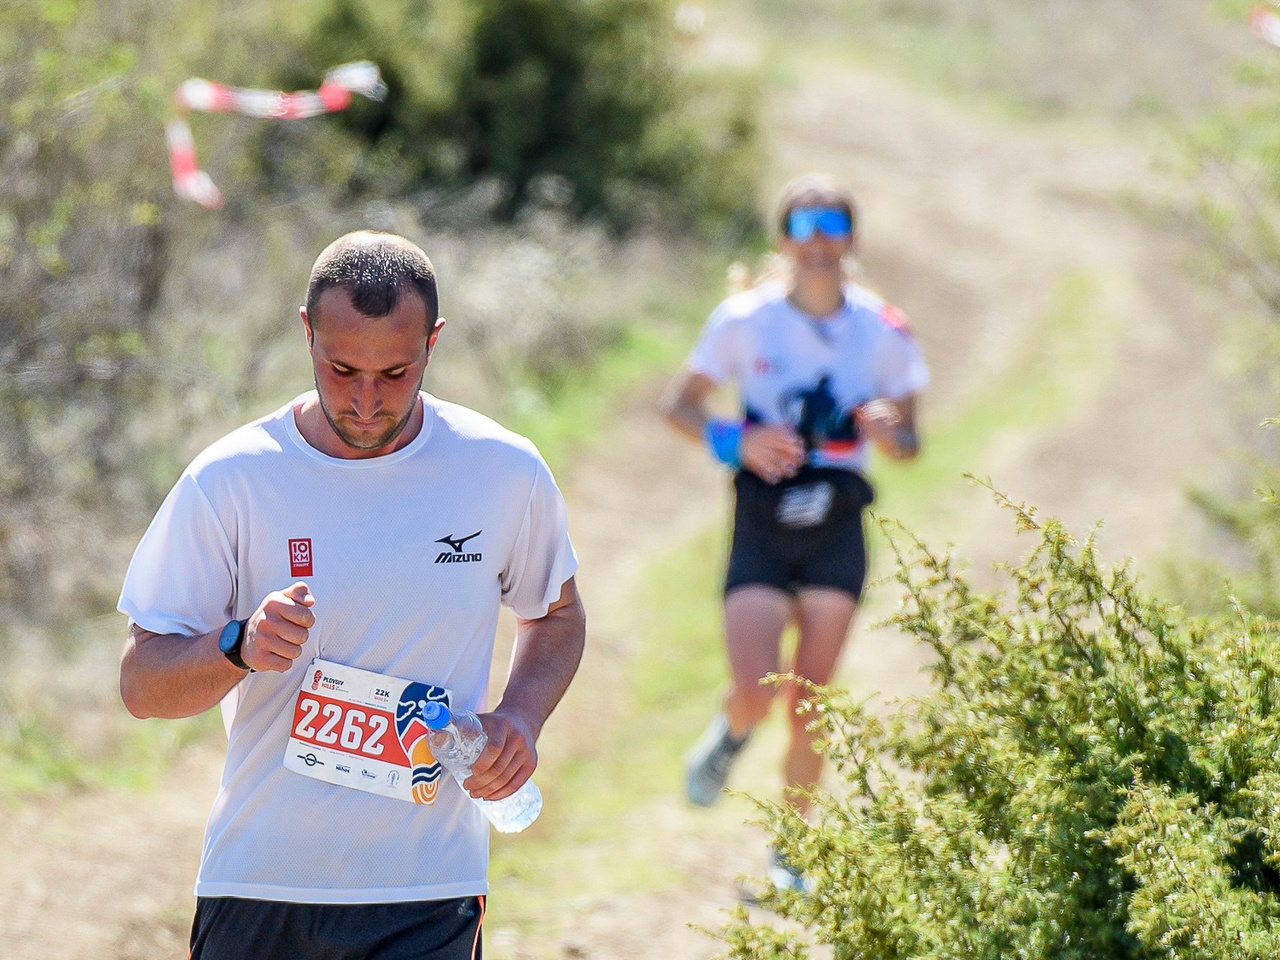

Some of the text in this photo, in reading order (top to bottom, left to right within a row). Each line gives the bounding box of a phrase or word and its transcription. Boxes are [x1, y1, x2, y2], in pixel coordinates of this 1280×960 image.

[293, 543, 308, 553] 10
[294, 553, 308, 561] KM
[434, 552, 482, 563] MIZUNO
[375, 688, 390, 697] 22K
[294, 698, 389, 756] 2262
